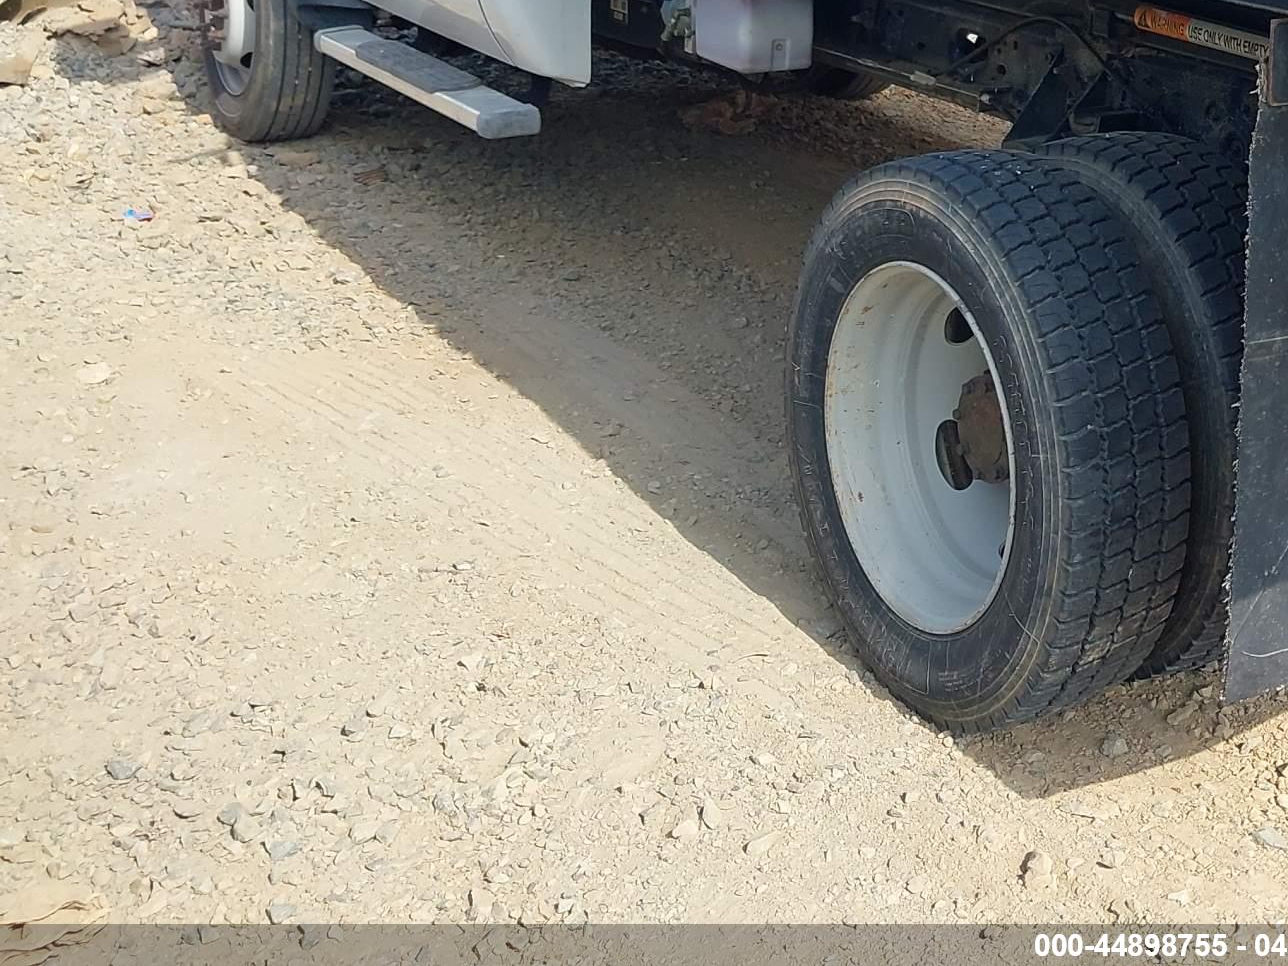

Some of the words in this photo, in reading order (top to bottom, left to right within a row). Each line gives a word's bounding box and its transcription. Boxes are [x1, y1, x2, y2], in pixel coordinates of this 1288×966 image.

[1150, 13, 1185, 36] WARNING
[1187, 25, 1203, 42] USE
[1203, 29, 1223, 46] ONLY
[1223, 35, 1241, 51] WITH
[1242, 40, 1269, 57] EMPTY
